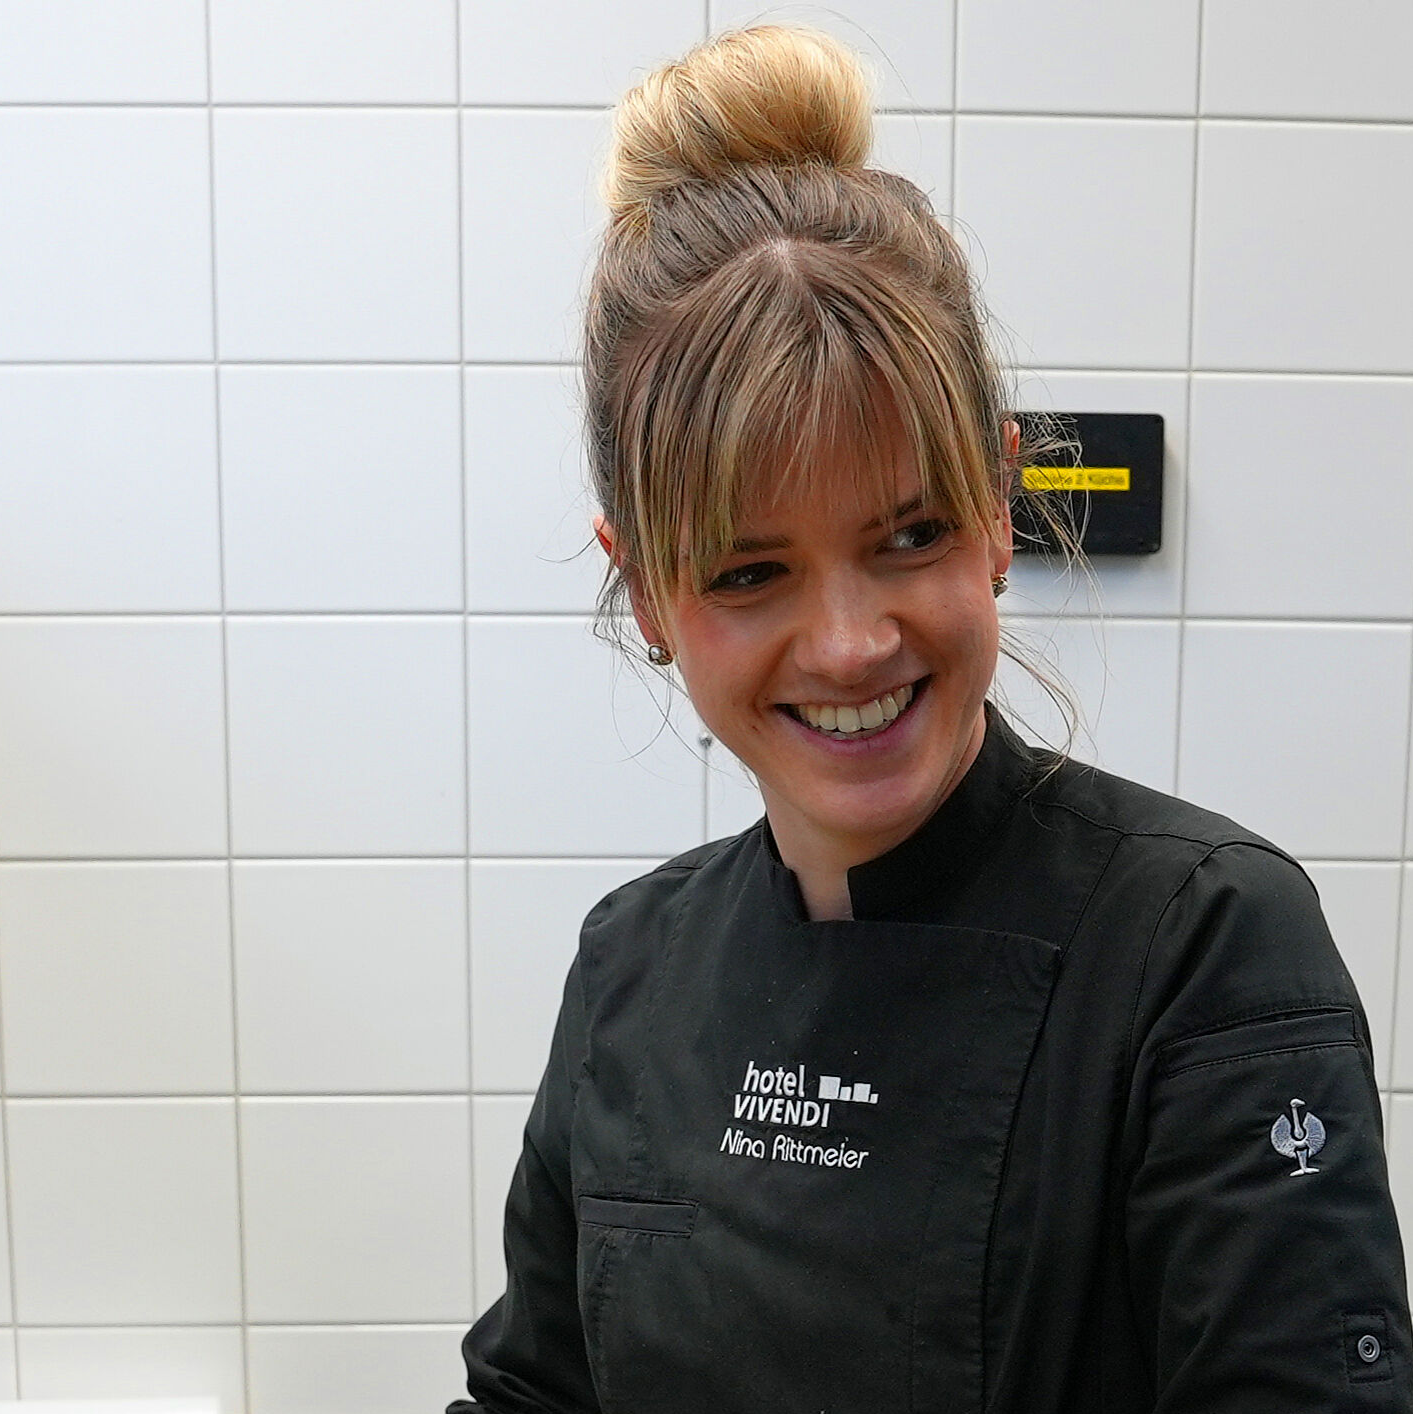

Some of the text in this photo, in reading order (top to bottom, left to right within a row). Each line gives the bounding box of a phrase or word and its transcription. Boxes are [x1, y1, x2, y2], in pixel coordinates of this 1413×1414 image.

[743, 1060, 805, 1098] hotel
[734, 1094, 831, 1128] VIVENDI
[720, 1127, 870, 1169] Nina Rittmeier
